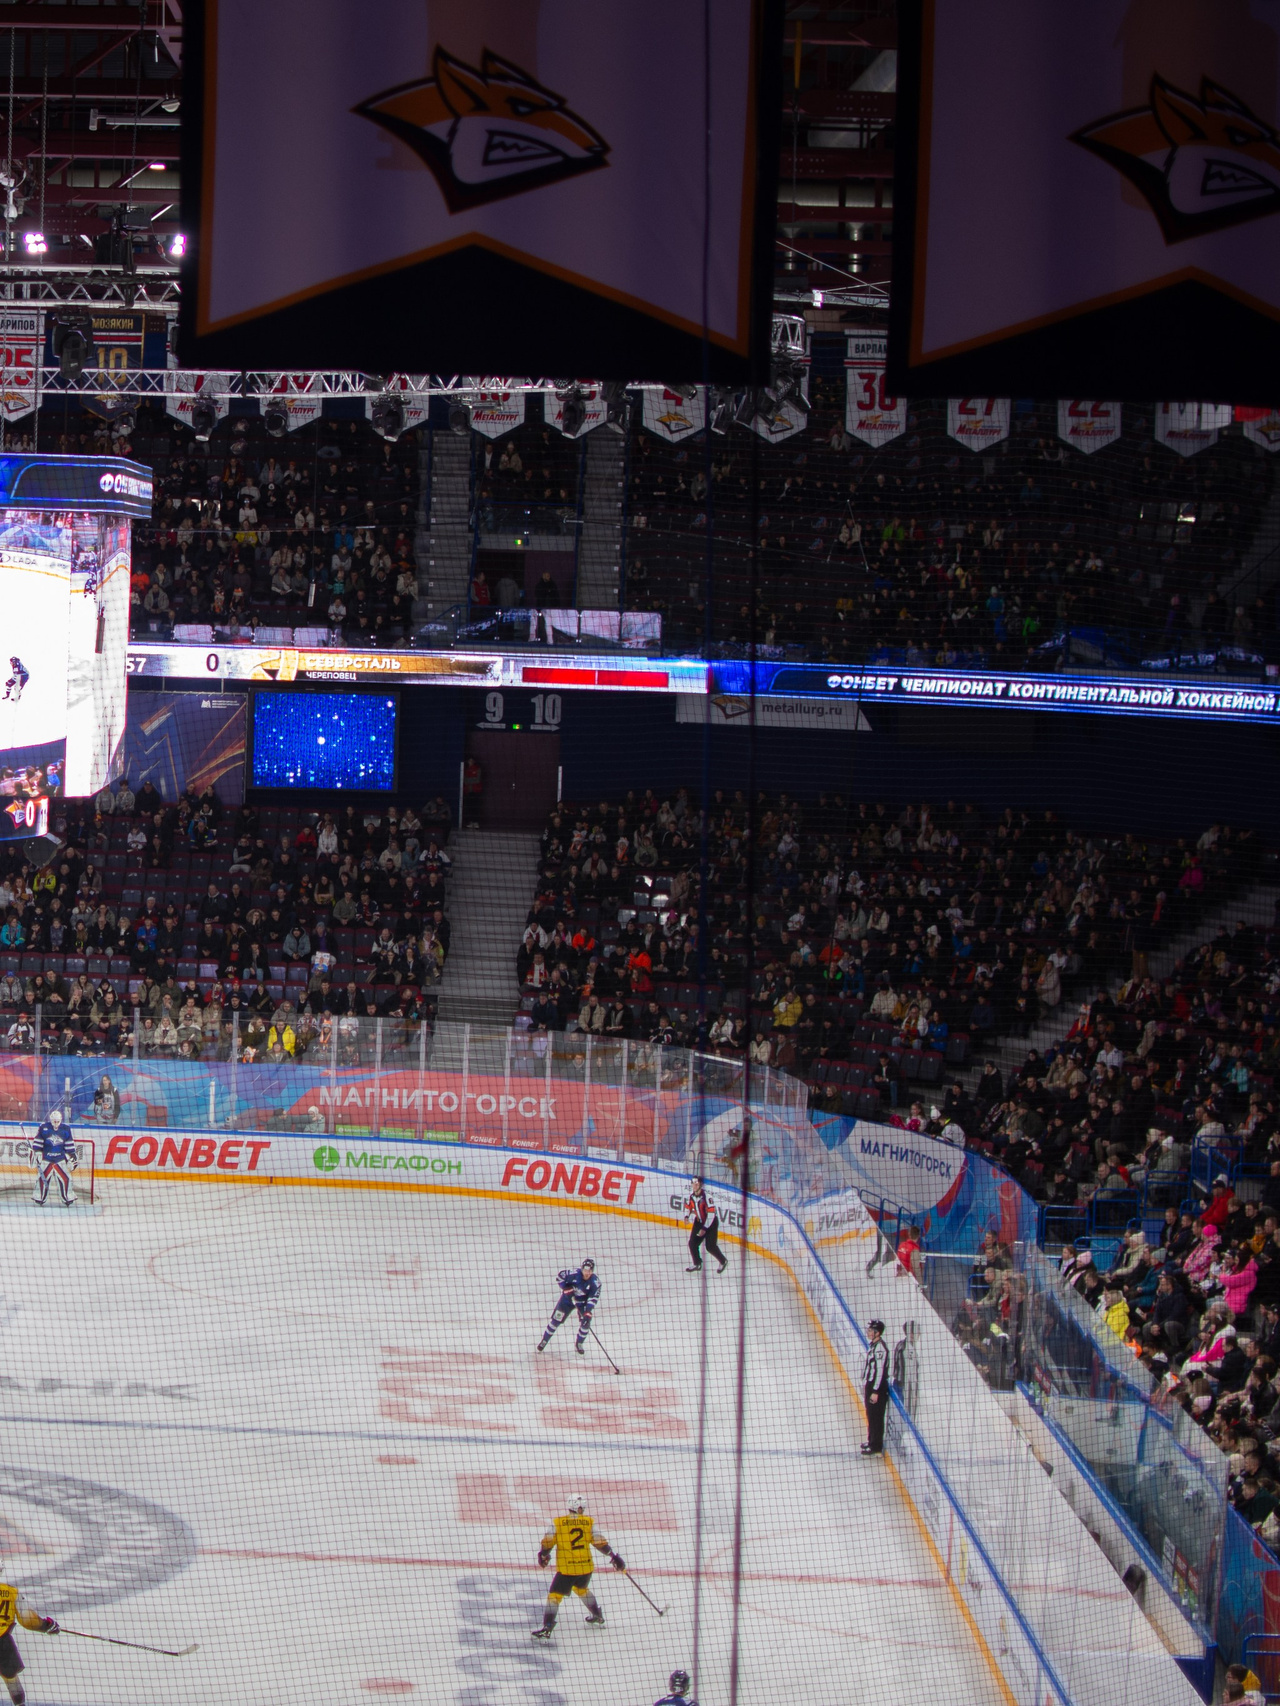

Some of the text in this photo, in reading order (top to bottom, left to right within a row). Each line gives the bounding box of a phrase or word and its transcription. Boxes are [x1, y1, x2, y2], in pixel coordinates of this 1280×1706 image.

[92, 318, 134, 329] МОЗЯКИН
[98, 347, 128, 384] 10
[472, 410, 519, 421] МЕТАЛЛУРГ
[857, 420, 900, 431] МЕТАЛЛУРГ
[956, 424, 1001, 436] МЕТАЛЛУРГ
[12, 555, 37, 566] LADA
[206, 653, 219, 672] 0
[305, 654, 402, 670] СЕВЕРСТАЛЬ
[305, 670, 357, 681] ЧЕРЕПОВЕЦ
[827, 675, 1275, 712] ФОНБЕТ ЧЕМПИОНАТ КОНТИНЕНТАЛЬНОЙ ХОККЕЙНОЙ
[485, 692, 504, 722] 9
[531, 694, 562, 724] 10
[761, 703, 843, 718] metallurg.ru
[319, 1086, 558, 1119] МАГНИТОГОРСК
[470, 1136, 497, 1144] FONBET
[512, 1139, 539, 1148] FONBET
[552, 1144, 578, 1153] FONBET
[104, 1135, 271, 1170] FONBET
[860, 1137, 952, 1180] МАГНИТОГОРСК
[345, 1151, 462, 1175] МЕГАФОН
[502, 1157, 645, 1205] FONBET
[570, 1528, 585, 1549] 2
